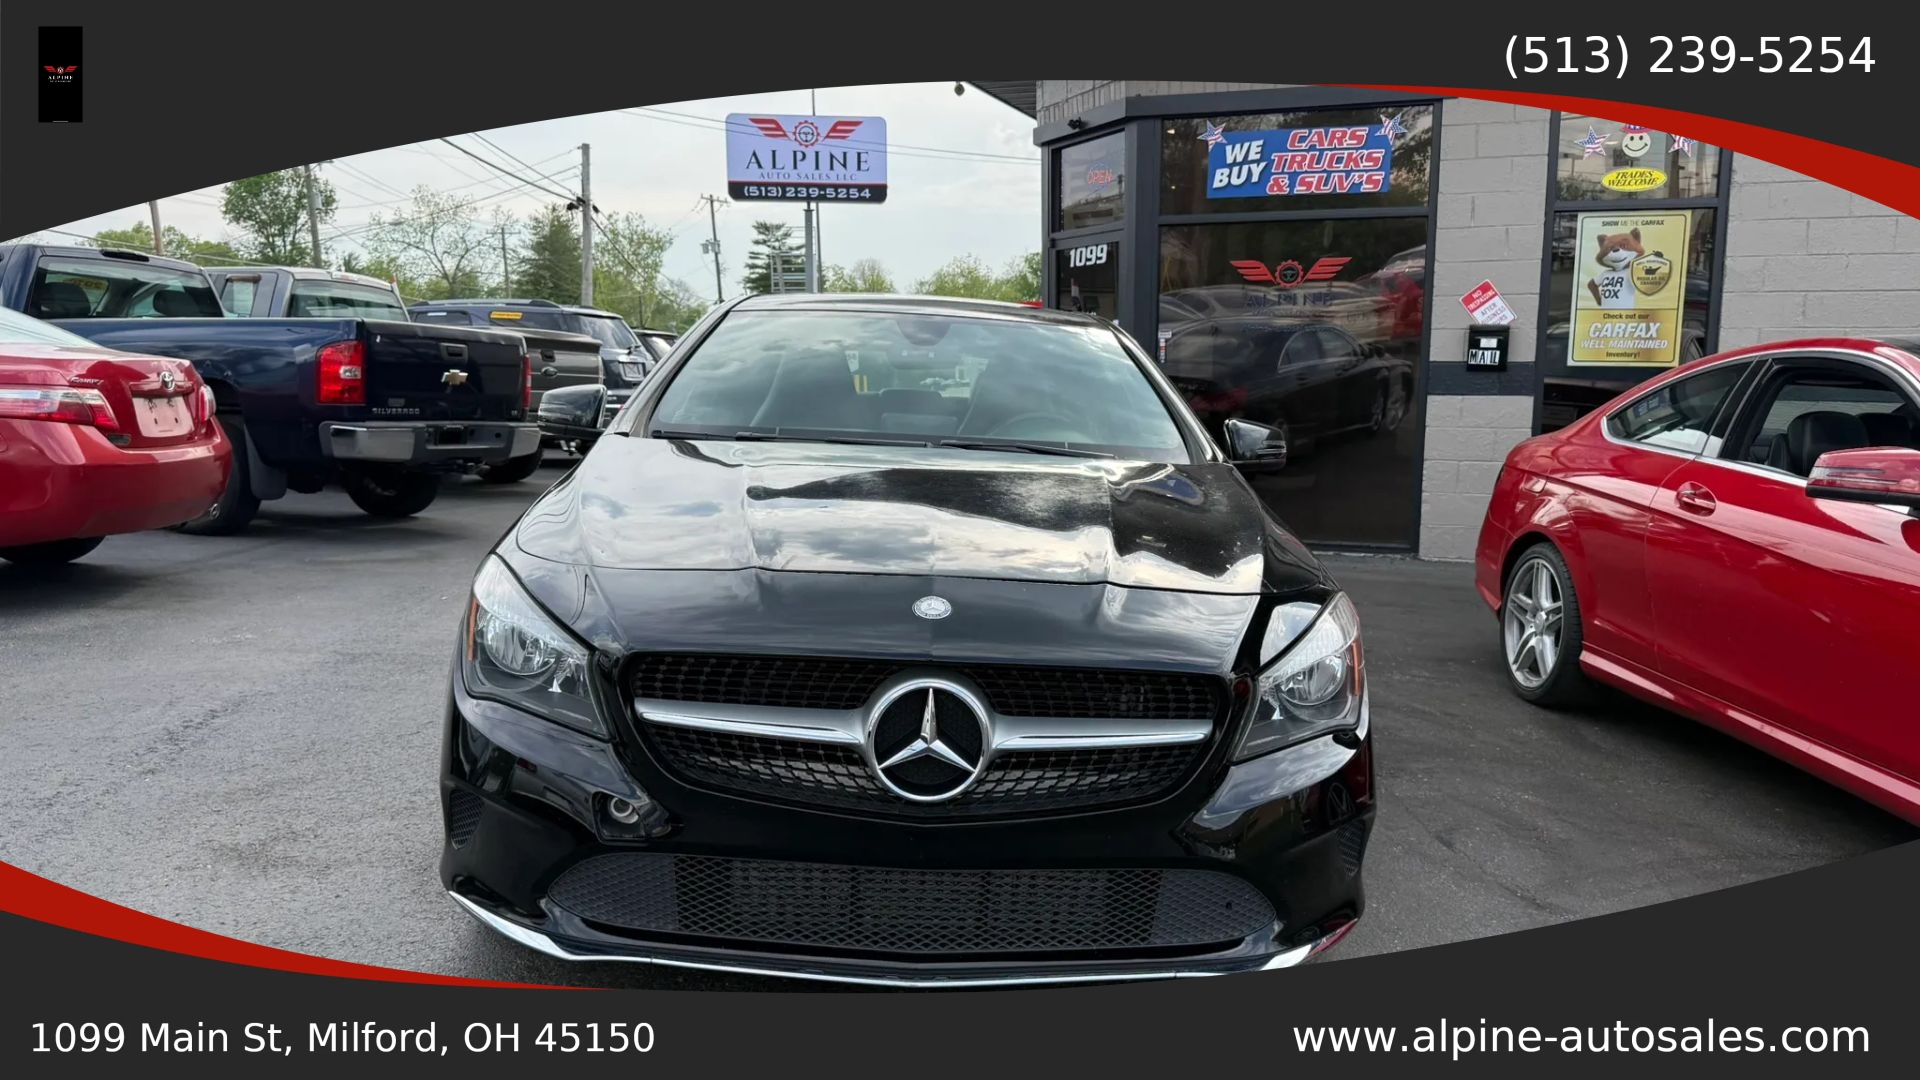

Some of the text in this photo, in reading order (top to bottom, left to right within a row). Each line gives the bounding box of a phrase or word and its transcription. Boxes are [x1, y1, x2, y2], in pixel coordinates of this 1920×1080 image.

[1287, 127, 1369, 150] CARS
[1225, 139, 1264, 164] WE
[746, 149, 870, 172] ALPINE
[1271, 149, 1385, 173] TRUCKS
[759, 172, 857, 181] AUTO SALES LLC
[1087, 168, 1112, 185] OPEN
[1213, 161, 1268, 189] BUY
[1616, 170, 1655, 179] TRADES
[1266, 172, 1385, 195] & SUV'S
[744, 186, 872, 199] (513) 239-5254
[1069, 244, 1108, 268] 1099
[1602, 276, 1624, 288] CAR
[1589, 322, 1660, 338] CARFAX
[1581, 340, 1668, 349] WELL MAINTAINED
[1469, 349, 1499, 364] MAIL
